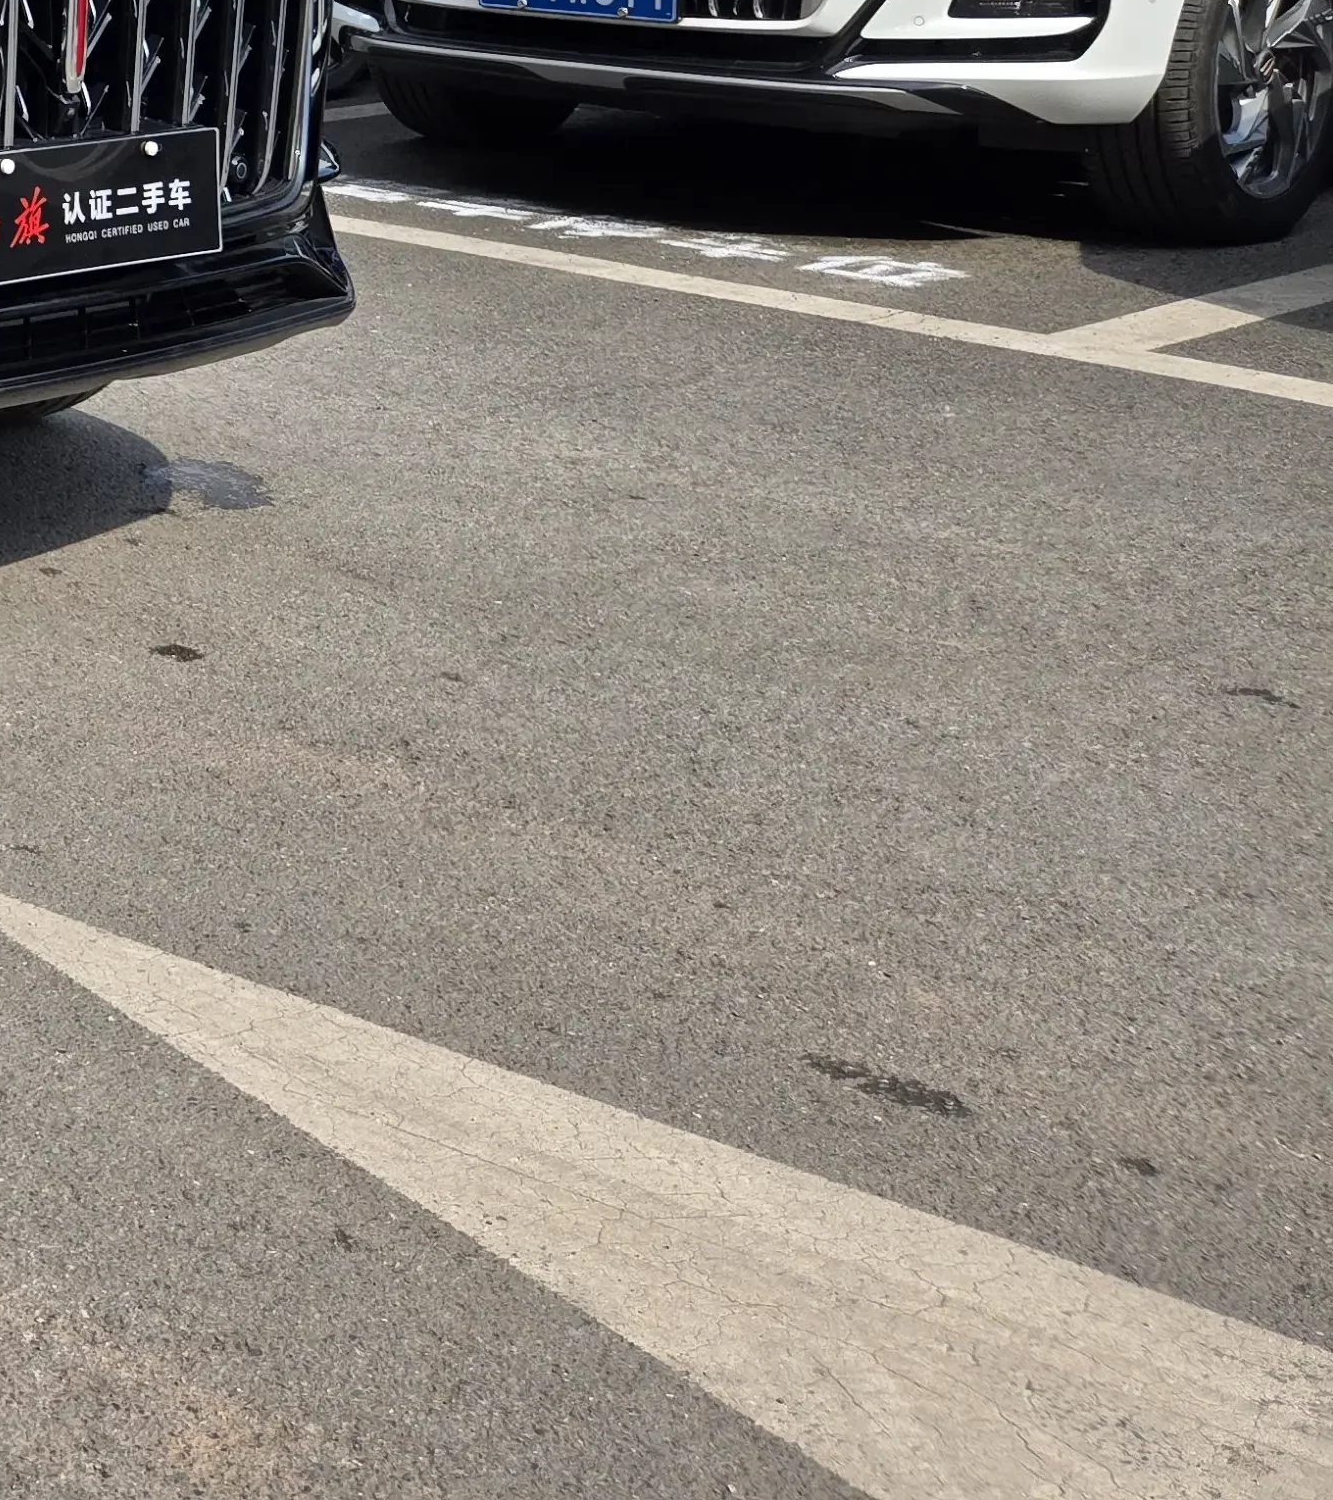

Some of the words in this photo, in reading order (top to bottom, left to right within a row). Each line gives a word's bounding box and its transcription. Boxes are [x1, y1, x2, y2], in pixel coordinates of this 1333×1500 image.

[62, 178, 192, 226] 认证二手车
[65, 230, 98, 244] HONGQI
[101, 224, 144, 239] CERTIFIED
[147, 220, 169, 232] USED
[172, 216, 190, 229] CAR
